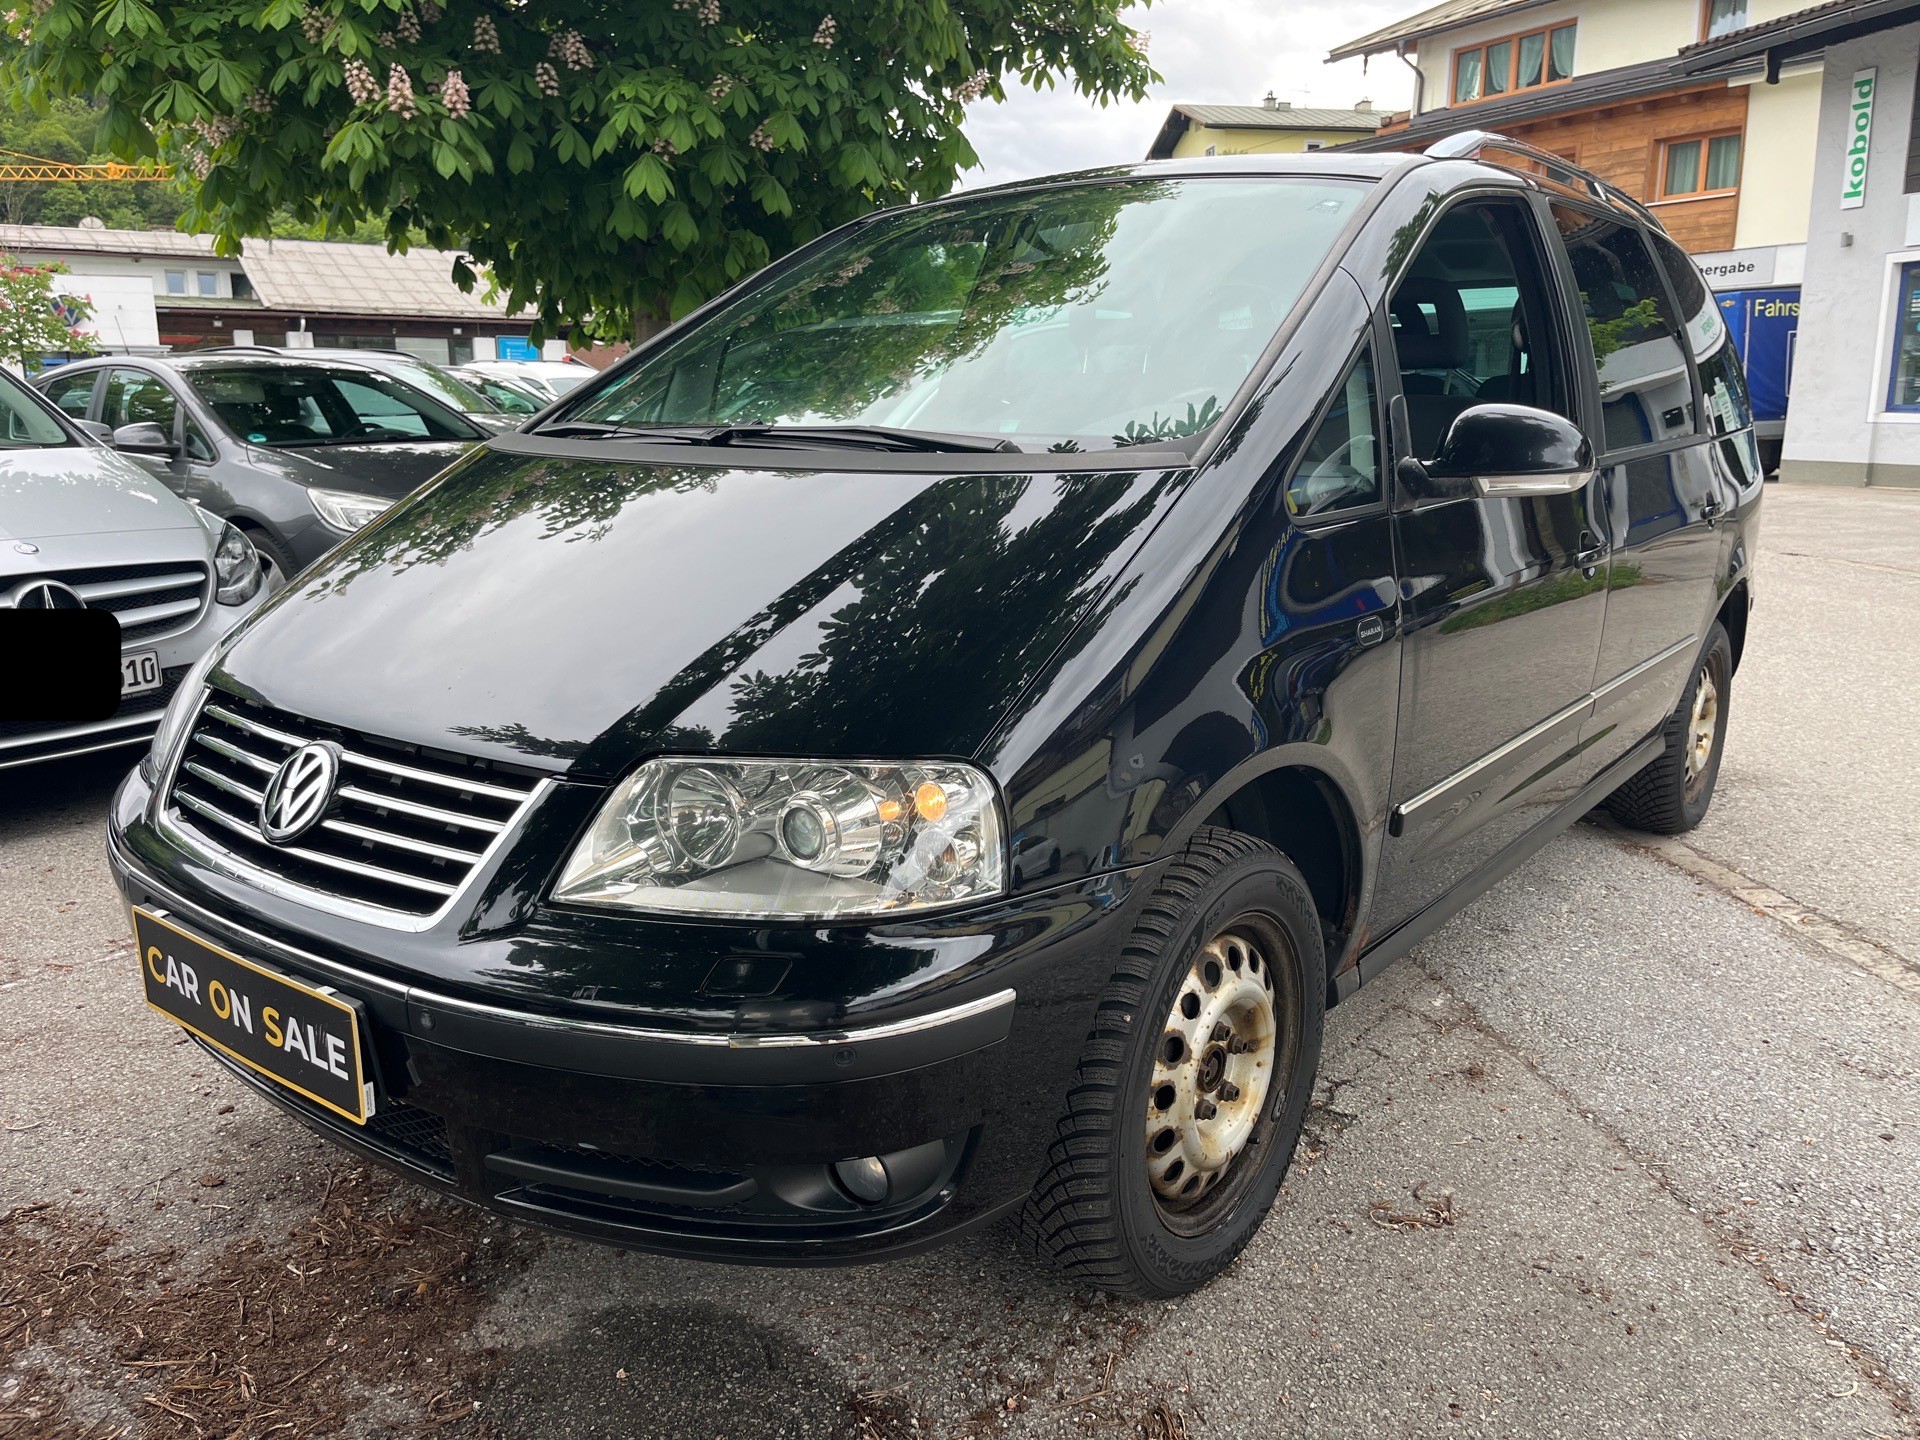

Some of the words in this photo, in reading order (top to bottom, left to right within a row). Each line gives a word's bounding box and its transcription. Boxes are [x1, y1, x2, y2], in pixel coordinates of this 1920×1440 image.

[1843, 78, 1873, 198] kobold
[1361, 625, 1381, 638] SHARAN
[147, 946, 201, 1005] CAR
[209, 980, 253, 1034] ON
[262, 1006, 349, 1081] SALE
